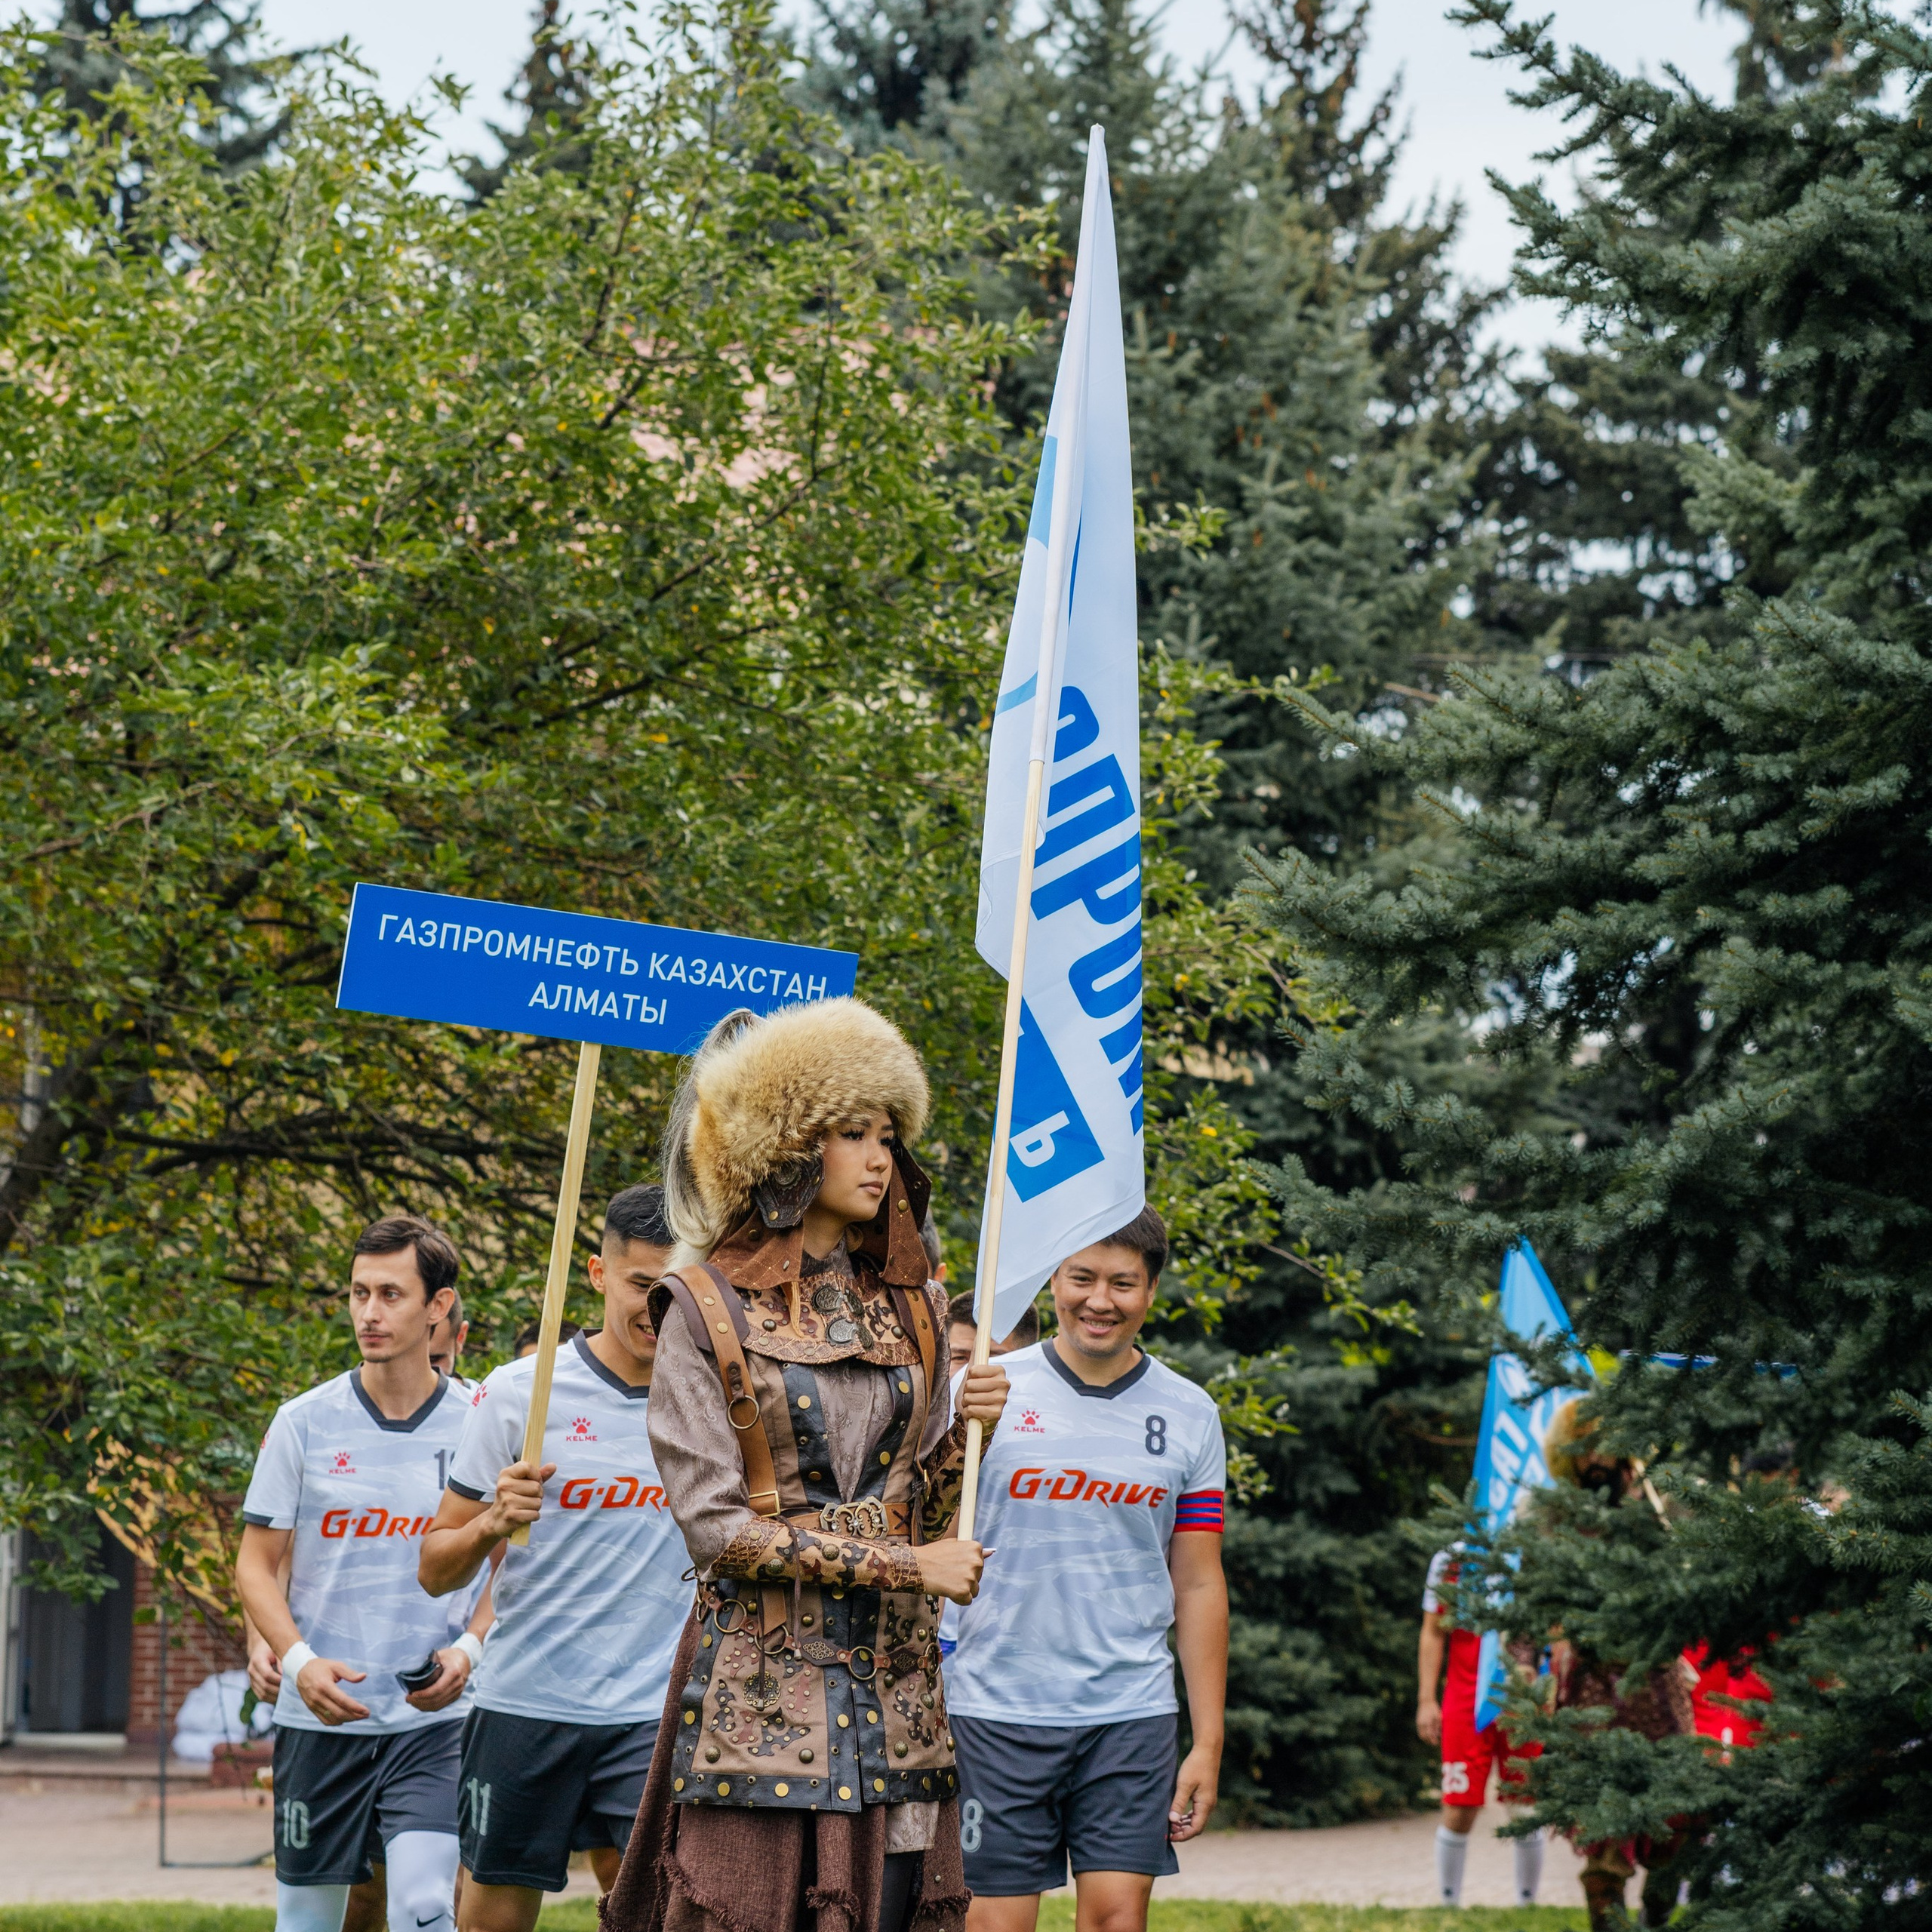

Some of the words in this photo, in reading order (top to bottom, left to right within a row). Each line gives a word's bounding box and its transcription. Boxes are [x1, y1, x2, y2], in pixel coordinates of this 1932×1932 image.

[378, 914, 639, 975] ГАЗПРОМНЕФТЬ
[648, 952, 827, 1001] КАЗАХСТАН
[528, 981, 667, 1026] АЛМАТЫ
[1014, 1425, 1045, 1434] KELME
[1145, 1414, 1168, 1457] 8
[283, 1798, 311, 1850] 10
[466, 1777, 492, 1836] 11
[960, 1798, 984, 1854] 8
